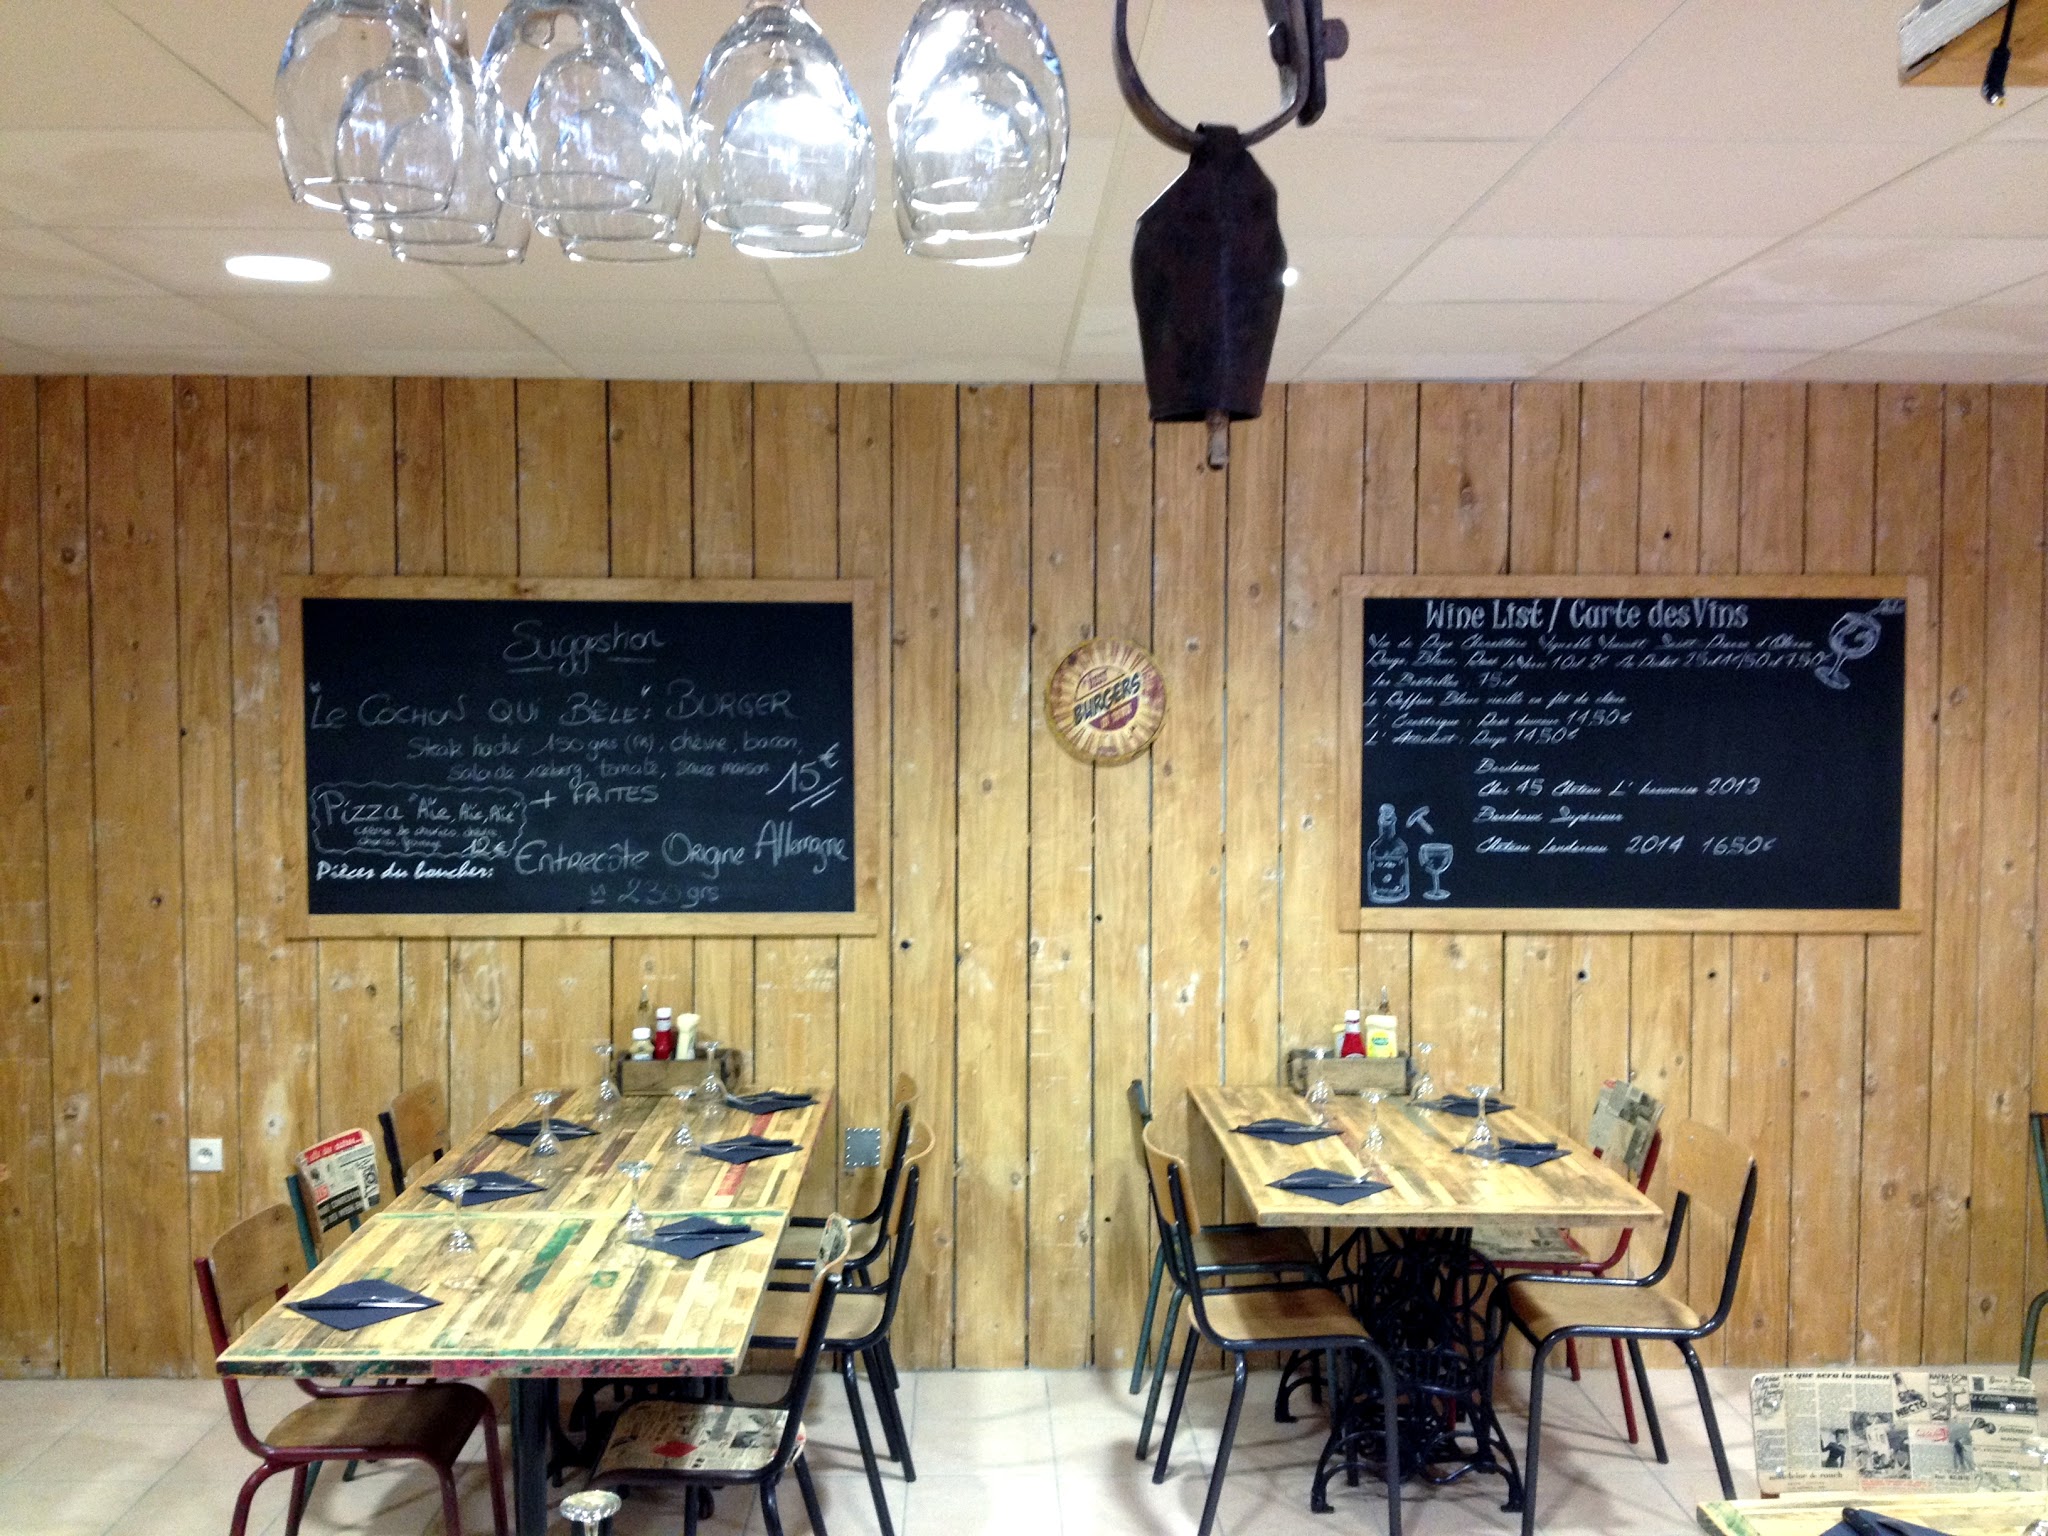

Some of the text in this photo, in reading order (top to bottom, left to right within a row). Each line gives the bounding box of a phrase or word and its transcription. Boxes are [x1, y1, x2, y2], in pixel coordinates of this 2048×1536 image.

[1425, 599, 1487, 630] Wine
[1491, 598, 1545, 630] List
[1569, 598, 1641, 630] Carte
[503, 619, 665, 677] Suggestion
[1073, 672, 1142, 725] BURGERS
[572, 781, 660, 805] FRITES
[1704, 776, 1761, 796] 2013
[318, 790, 404, 825] Pizza
[1624, 835, 1685, 855] 2014
[316, 860, 376, 881] Pièces
[381, 861, 409, 879] du
